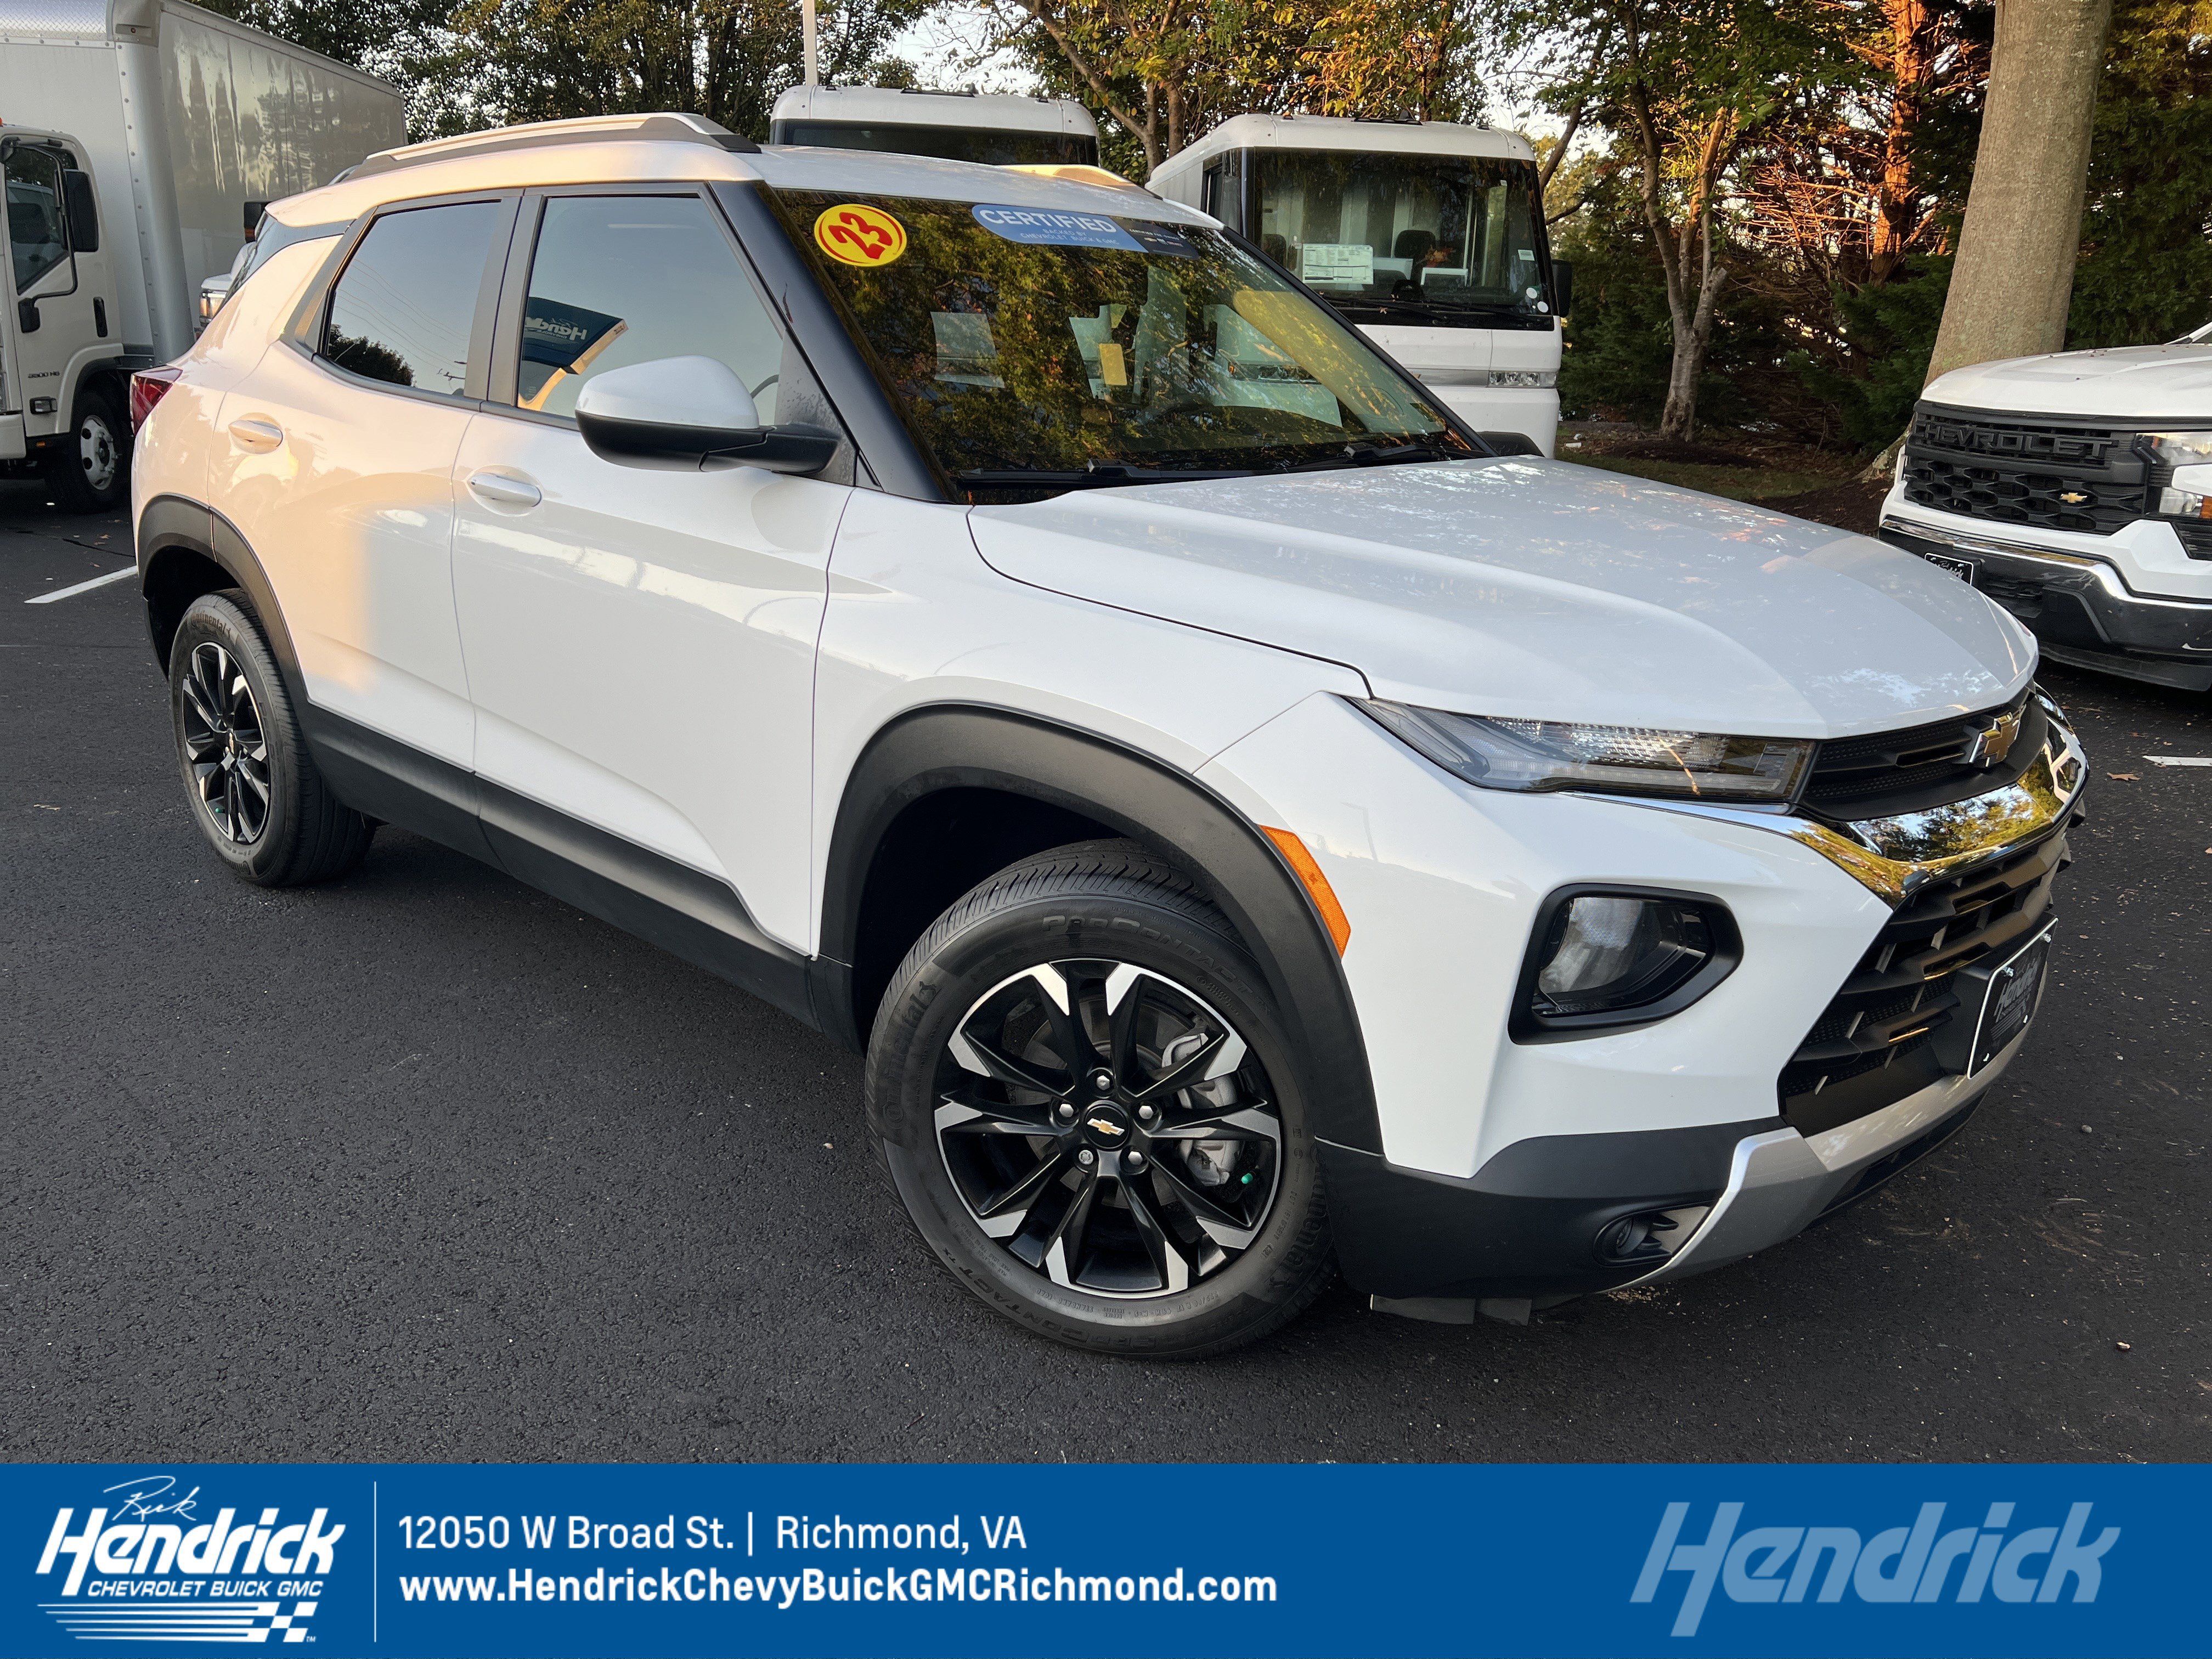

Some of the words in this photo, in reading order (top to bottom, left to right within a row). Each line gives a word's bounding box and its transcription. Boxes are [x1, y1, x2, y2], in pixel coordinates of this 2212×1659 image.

[828, 212, 893, 260] 23
[979, 208, 1118, 233] CERTIFIED
[1915, 423, 2113, 457] CHEVROLET
